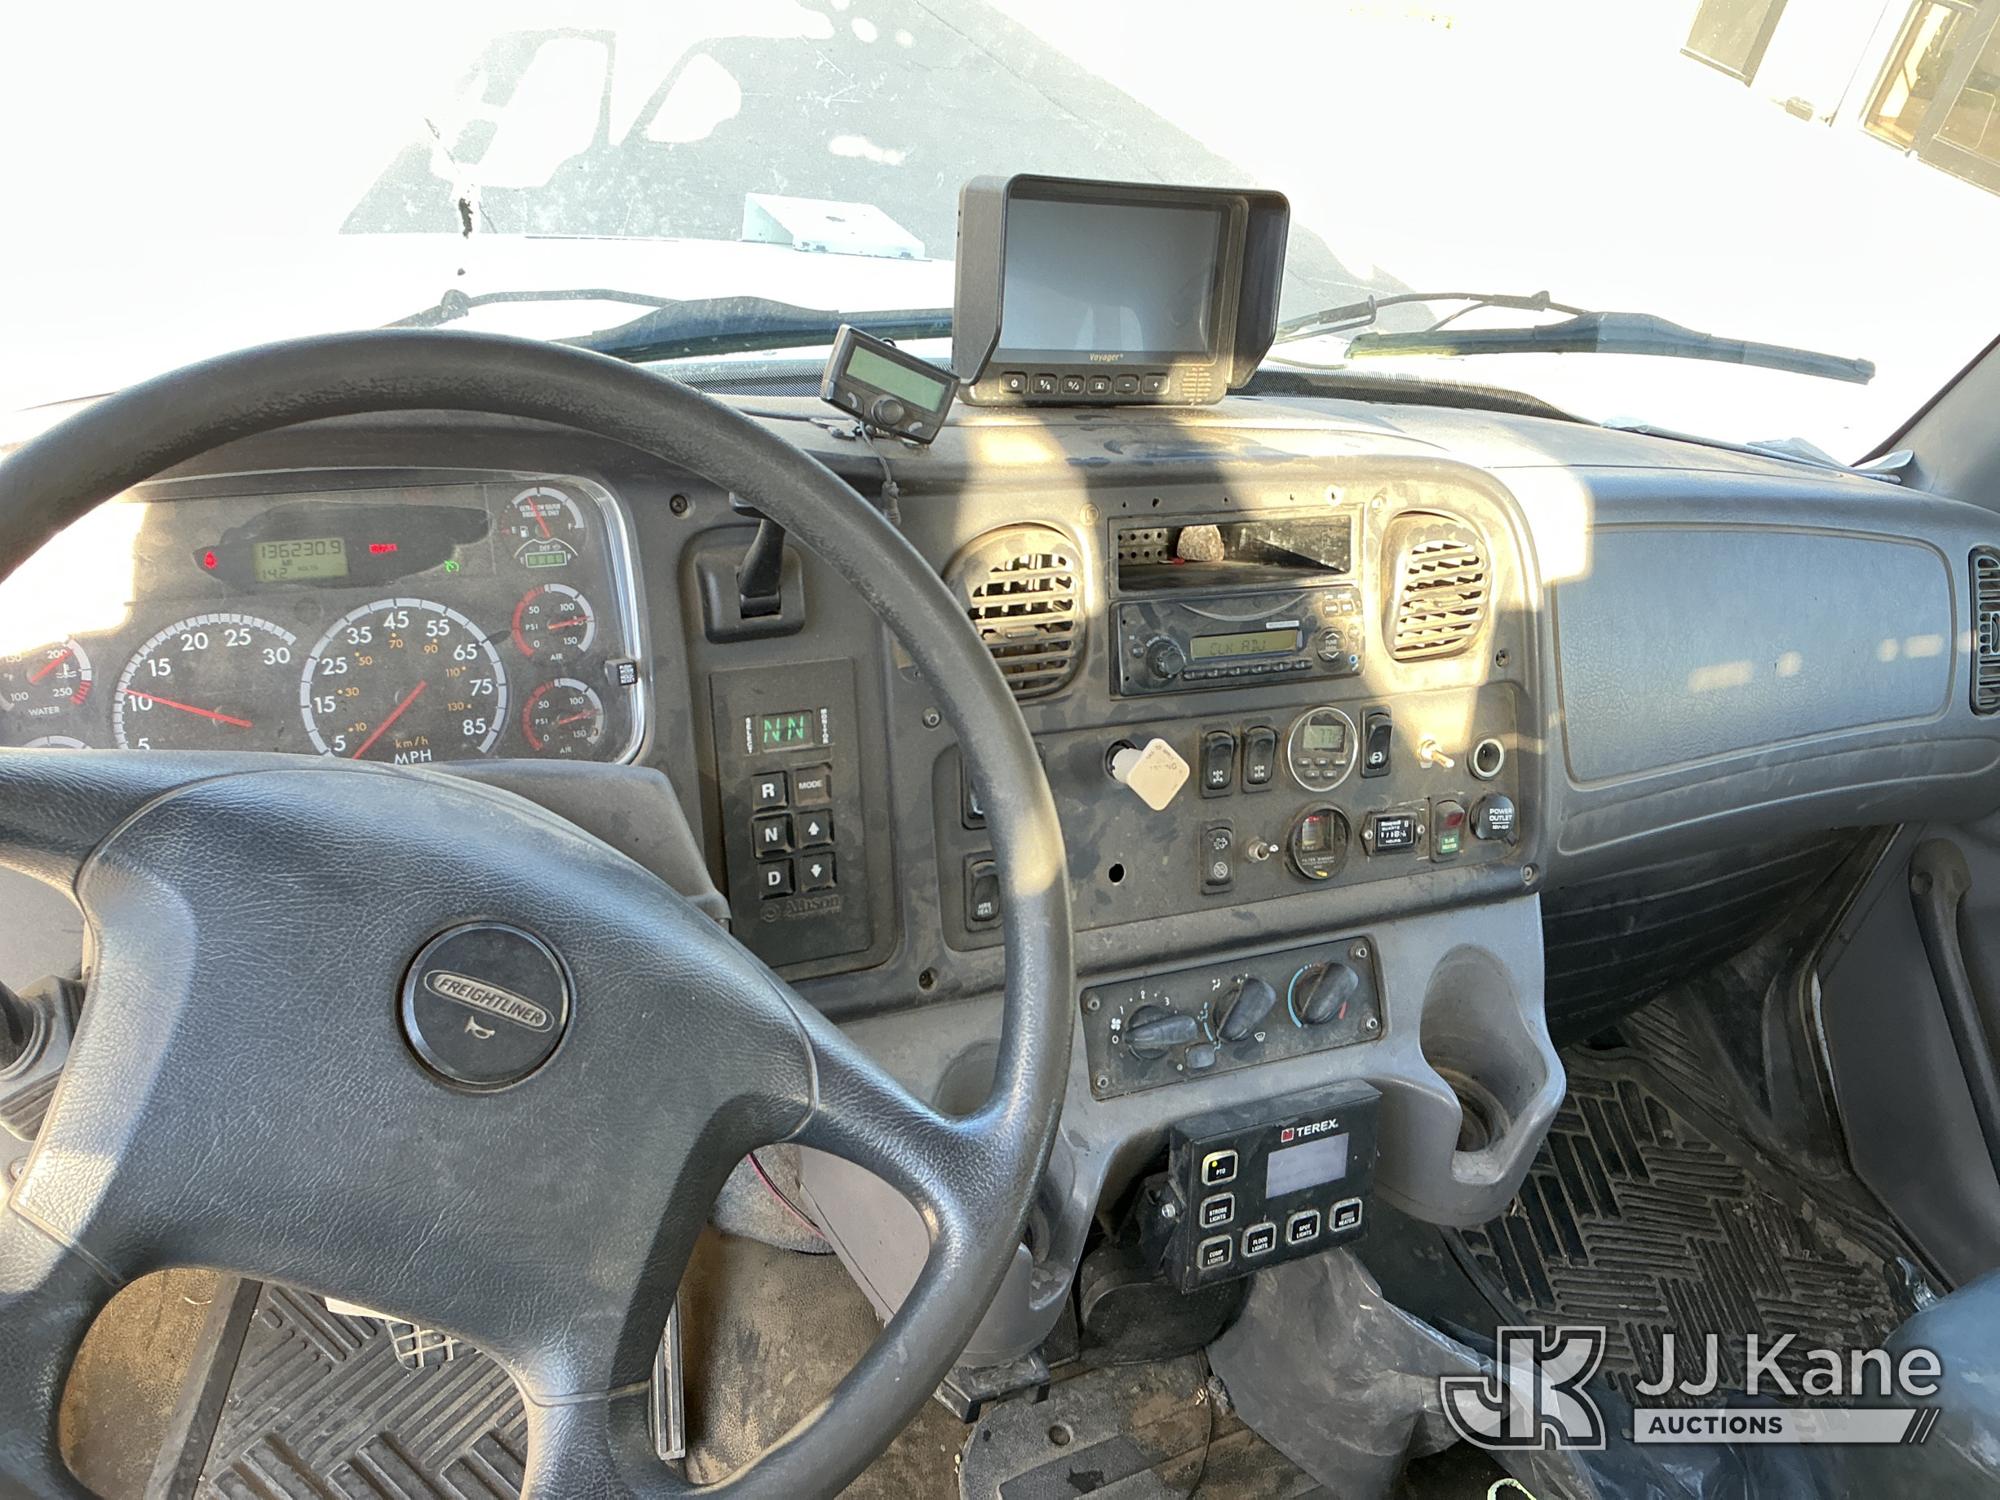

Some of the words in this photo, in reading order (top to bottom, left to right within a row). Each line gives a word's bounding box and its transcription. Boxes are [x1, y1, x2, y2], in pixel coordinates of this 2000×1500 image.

[1089, 352, 1120, 362] Voyager
[528, 606, 540, 614] 50
[560, 603, 575, 612] 100
[383, 611, 410, 629] 45
[425, 619, 450, 637] 55
[224, 628, 251, 647] 25
[346, 626, 372, 644] 35
[180, 632, 209, 651] 20
[389, 639, 403, 648] 70
[563, 637, 578, 645] 150
[423, 645, 438, 654] 90
[453, 643, 478, 661] 65
[263, 647, 290, 665] 30
[358, 656, 373, 666] 50
[550, 653, 563, 661] AIR
[148, 658, 172, 676] 15
[321, 657, 348, 675] 25
[445, 668, 460, 677] 110
[52, 687, 73, 697] 250
[345, 687, 359, 696] 30
[469, 678, 493, 696] 75
[10, 692, 29, 702] 100
[569, 697, 584, 705] 100
[128, 695, 153, 712] 10
[313, 696, 336, 714] 15
[447, 702, 465, 711] 130
[538, 701, 549, 709] 50
[28, 706, 60, 716] WATER
[355, 722, 367, 731] 10
[462, 718, 487, 735] 85
[334, 735, 346, 752] 5
[395, 736, 429, 748] km/h
[394, 749, 432, 765] MPH
[798, 780, 823, 790] MODE
[762, 783, 775, 798] R
[765, 827, 778, 842] N
[768, 871, 781, 886] D
[438, 978, 541, 1024] FREIGHTLINER
[1296, 1118, 1337, 1137] TEREX
[1209, 1206, 1228, 1217] STROBE
[1209, 1213, 1226, 1223] LIGHTS
[1338, 1217, 1355, 1226] HEATER
[1299, 1223, 1311, 1232] SPOT
[1296, 1229, 1312, 1239] LIGHTS
[1252, 1236, 1268, 1246] FLOOD
[1252, 1243, 1268, 1253] LIGHTS
[1209, 1249, 1223, 1258] COMP
[1208, 1255, 1224, 1265] LIGHTS
